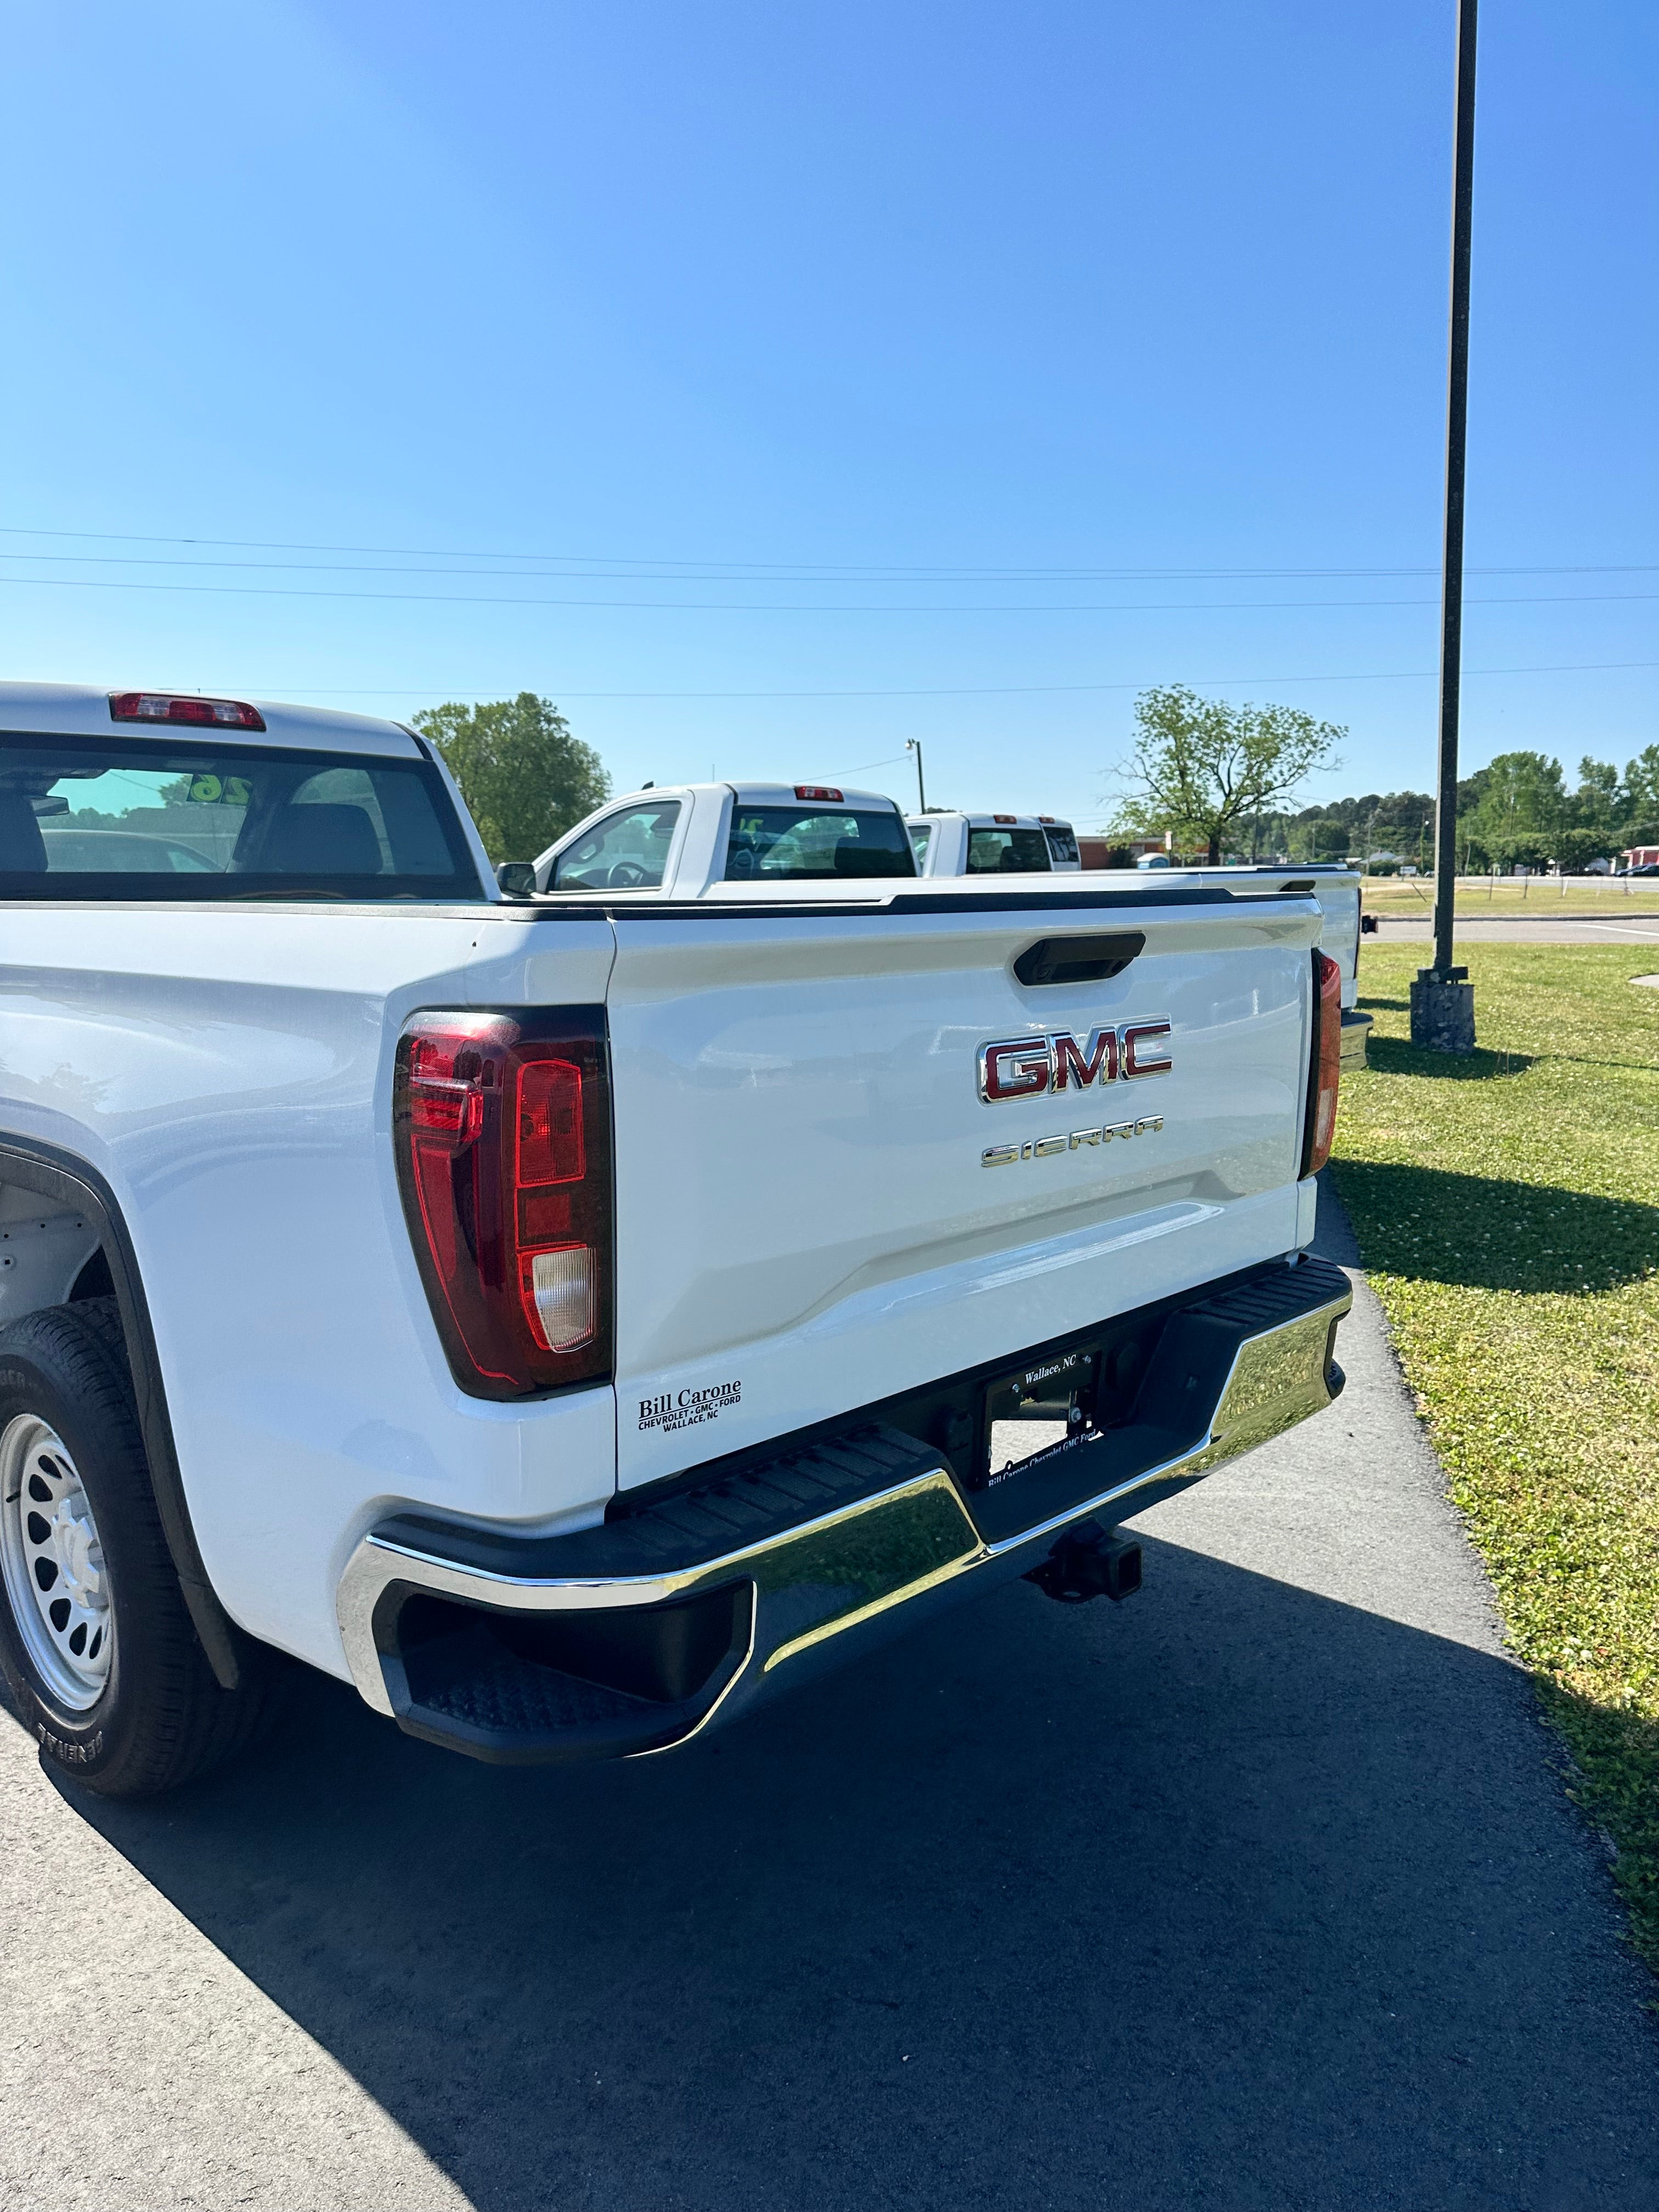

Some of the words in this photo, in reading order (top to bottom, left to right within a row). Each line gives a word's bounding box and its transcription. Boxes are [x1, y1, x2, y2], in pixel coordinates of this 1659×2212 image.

[977, 1018, 1172, 1104] GMC
[981, 1114, 1164, 1167] SIERRA
[1025, 1364, 1062, 1385] Wallace,
[1062, 1354, 1076, 1369] NC
[638, 1393, 672, 1419] Bill
[678, 1380, 741, 1407] Carone
[638, 1409, 689, 1430] CHEVROLET
[695, 1402, 713, 1414] GMC
[719, 1395, 741, 1407] FORD
[663, 1415, 706, 1432] WALLACE,
[707, 1409, 719, 1420] NC
[1063, 1436, 1080, 1451] GMC
[1080, 1428, 1096, 1443] Ford
